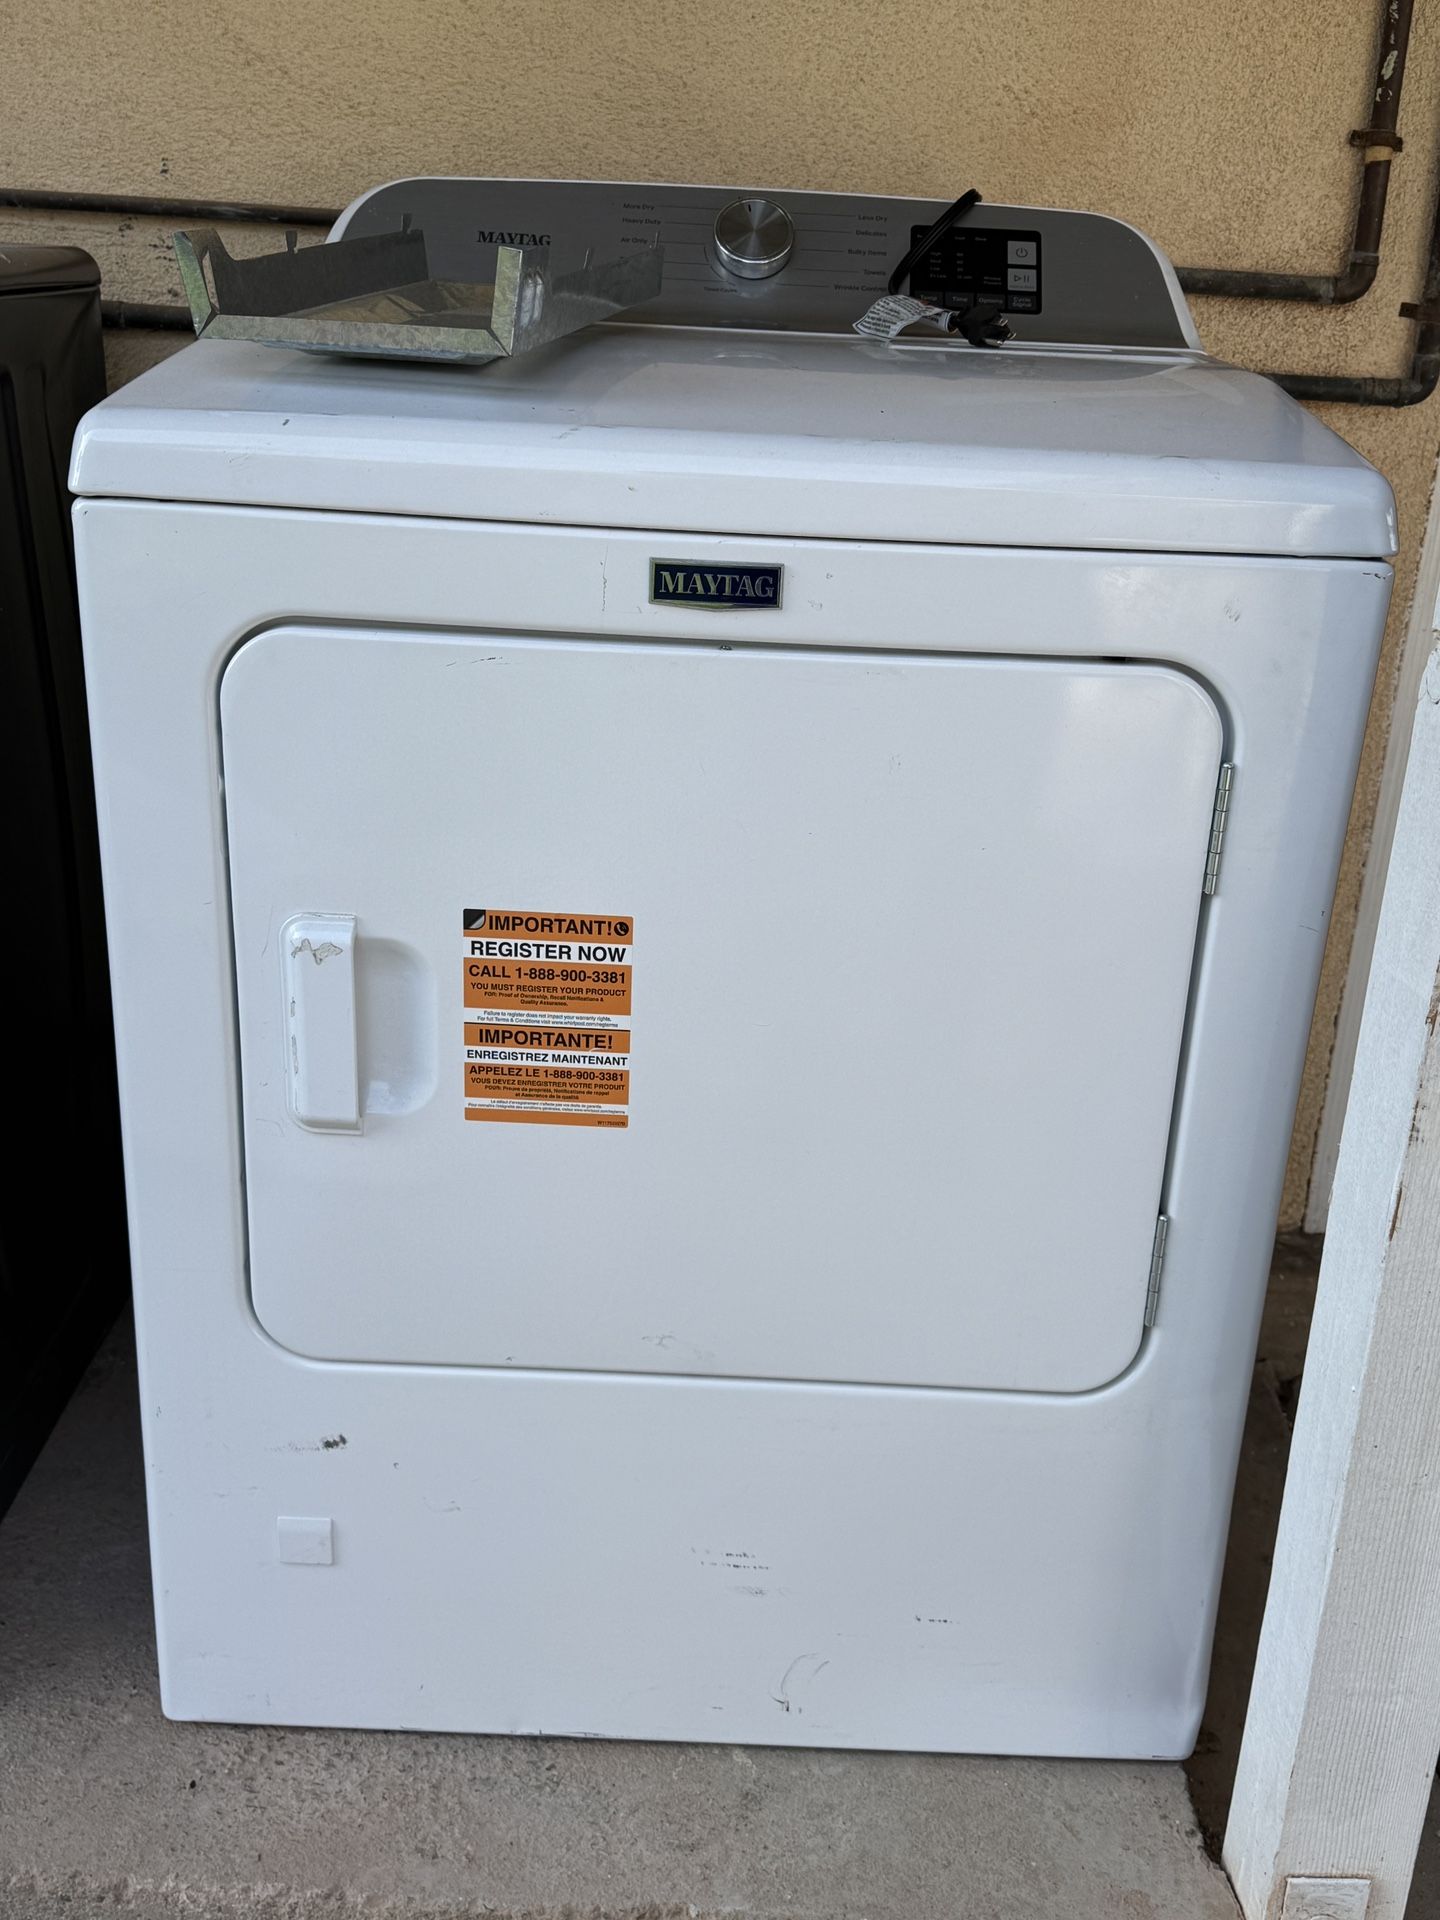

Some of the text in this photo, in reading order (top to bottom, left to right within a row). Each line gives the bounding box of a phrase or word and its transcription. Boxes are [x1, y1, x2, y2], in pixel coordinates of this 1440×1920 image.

[875, 215, 888, 223] Dry
[477, 230, 552, 246] MAYTAG
[848, 248, 866, 256] Bulky
[660, 571, 774, 598] MAYTAG
[488, 915, 612, 936] IMPORTANT!
[470, 940, 626, 962] REGISTER NOW
[468, 964, 626, 984] CALL 1-888-900-3381
[470, 982, 488, 990] YOU
[516, 985, 558, 994] REGISTER
[560, 986, 584, 994] YOUR
[586, 988, 626, 996] PRODUCT
[479, 1028, 612, 1049] IMPORTANTE!
[466, 1050, 628, 1066] ENREGISTREZ MAINTENANT
[469, 1066, 624, 1081] APPELEZ LE 1-888-900-3381
[518, 1080, 567, 1088] ENREGISTRER
